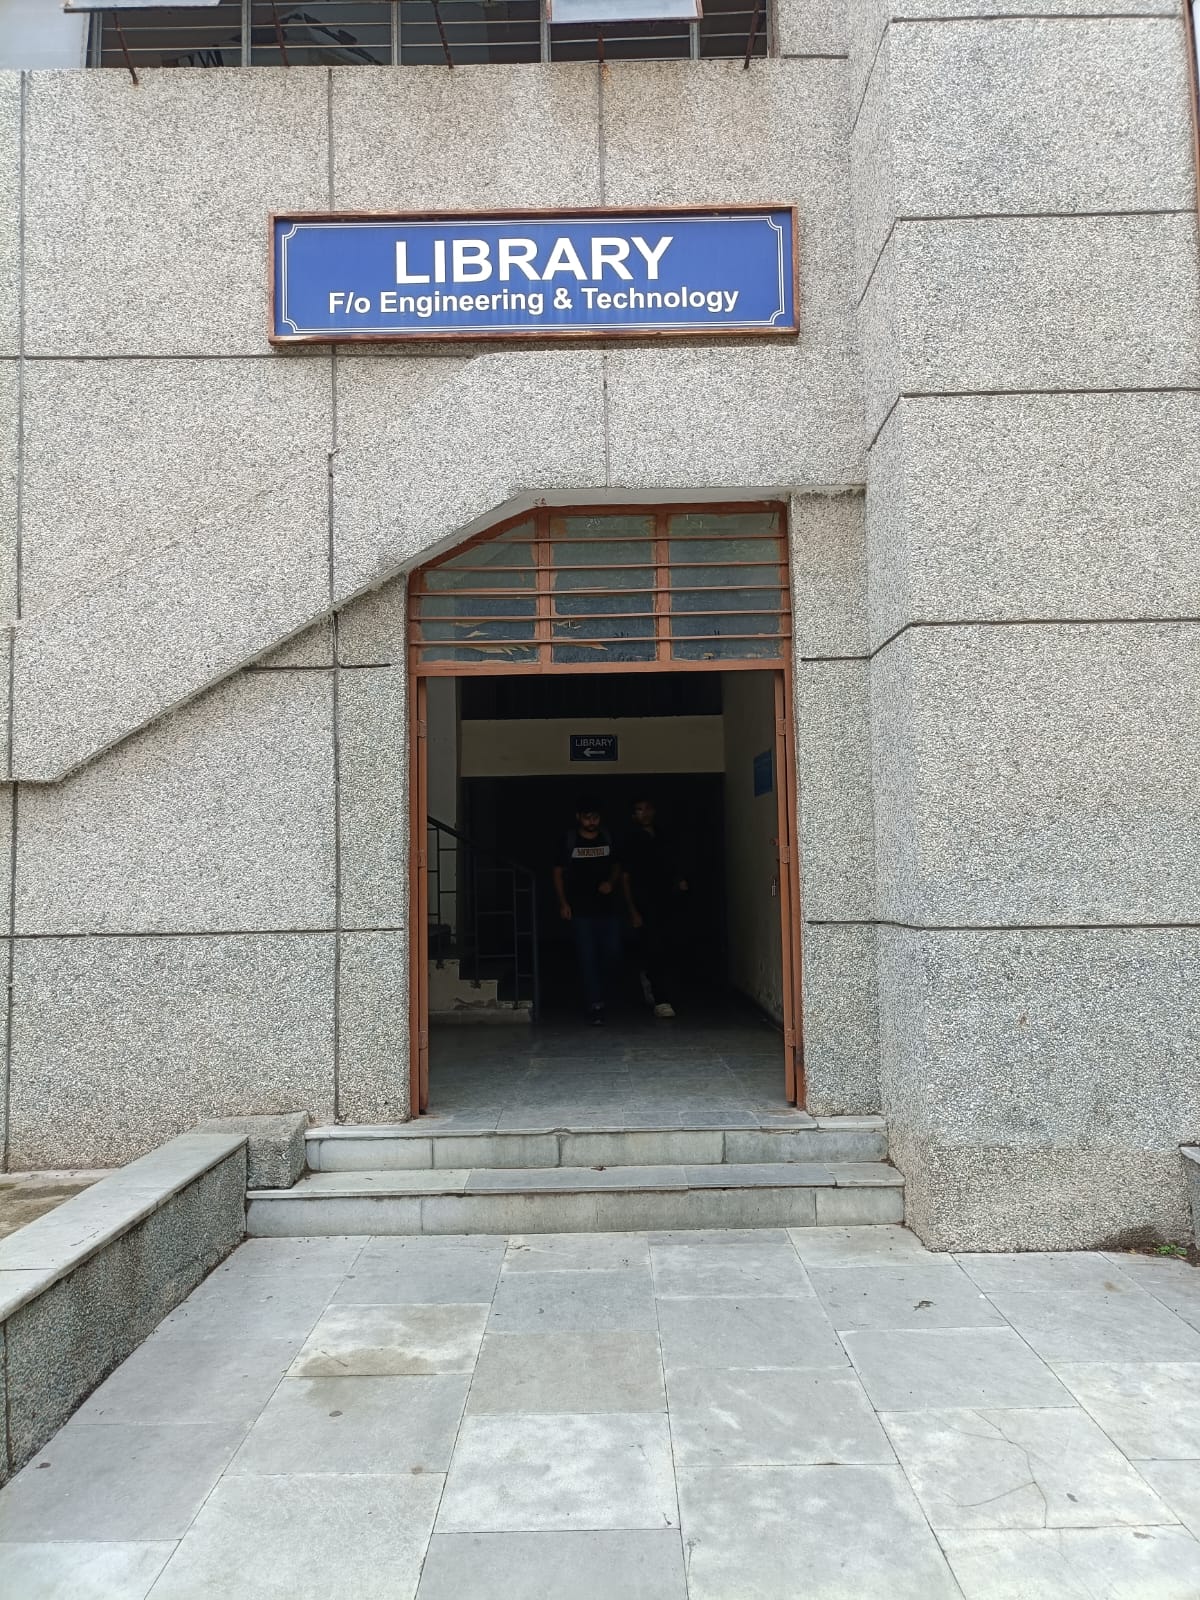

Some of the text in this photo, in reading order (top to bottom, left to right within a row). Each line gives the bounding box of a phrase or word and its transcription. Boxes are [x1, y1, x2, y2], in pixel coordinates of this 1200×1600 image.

[394, 235, 675, 285] LIBRARY
[328, 286, 740, 318] F/o Engineering & Technology
[575, 738, 614, 747] LIBRARY
